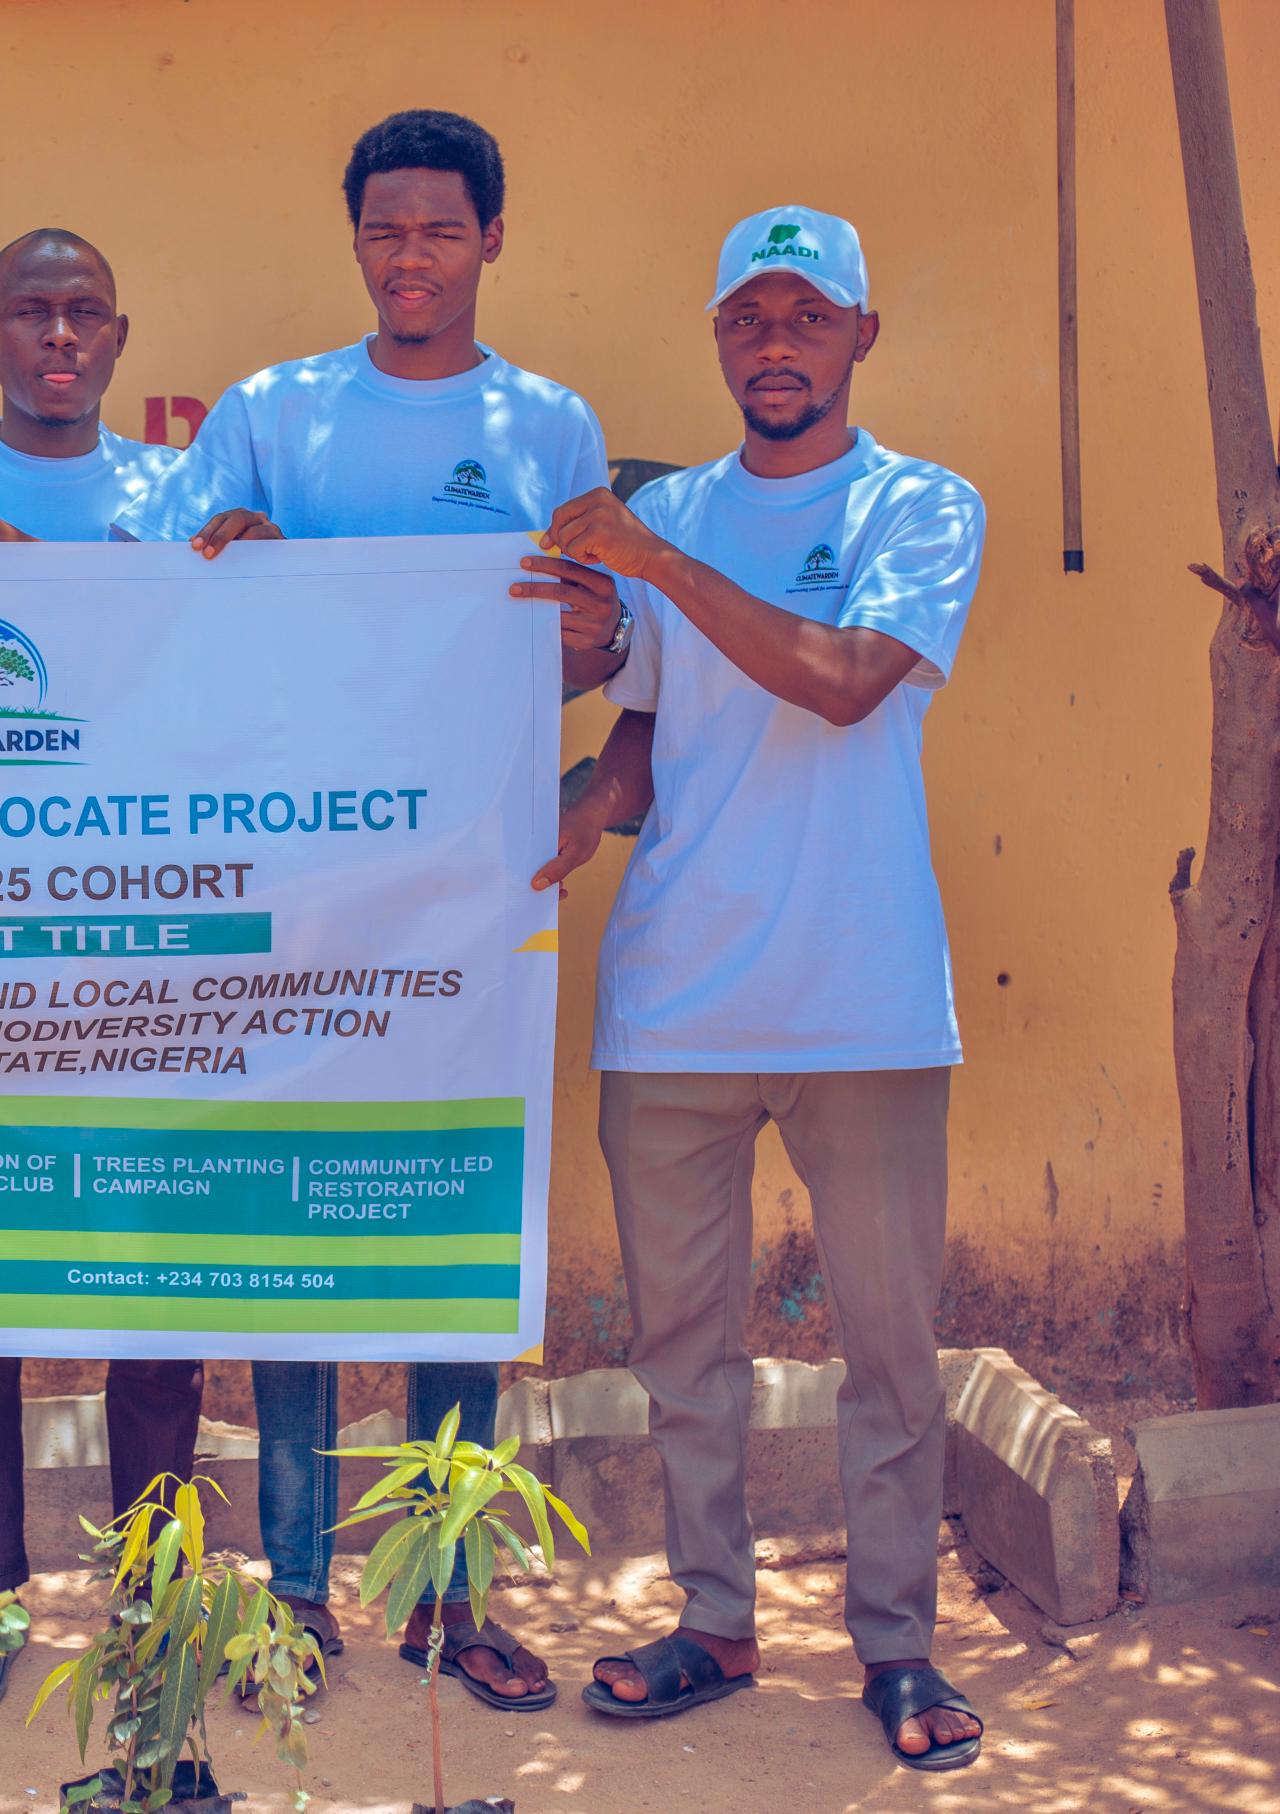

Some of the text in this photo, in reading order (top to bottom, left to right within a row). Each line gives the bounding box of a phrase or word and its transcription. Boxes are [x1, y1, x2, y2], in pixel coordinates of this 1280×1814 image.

[752, 245, 819, 262] NAADI
[444, 485, 490, 499] CLIMATEWARDEN
[795, 572, 839, 582] CLIMATEWARDEN
[189, 789, 427, 834] PROJECT
[48, 864, 253, 901] COHORT
[40, 924, 189, 950] TITLE
[49, 980, 178, 1008] LOCAL
[193, 969, 462, 1001] COMMUNITIES
[241, 1009, 390, 1037] ACTION
[27, 1155, 56, 1170] OF
[93, 1157, 284, 1174] TREES PLANTING
[309, 1156, 492, 1175] COMMUNITY LED
[93, 1178, 209, 1194] CAMPAIGN
[309, 1180, 464, 1197] RESTORATION
[309, 1204, 411, 1219] PROJECT
[68, 1269, 334, 1288] Contact: +234 703 8154 504
